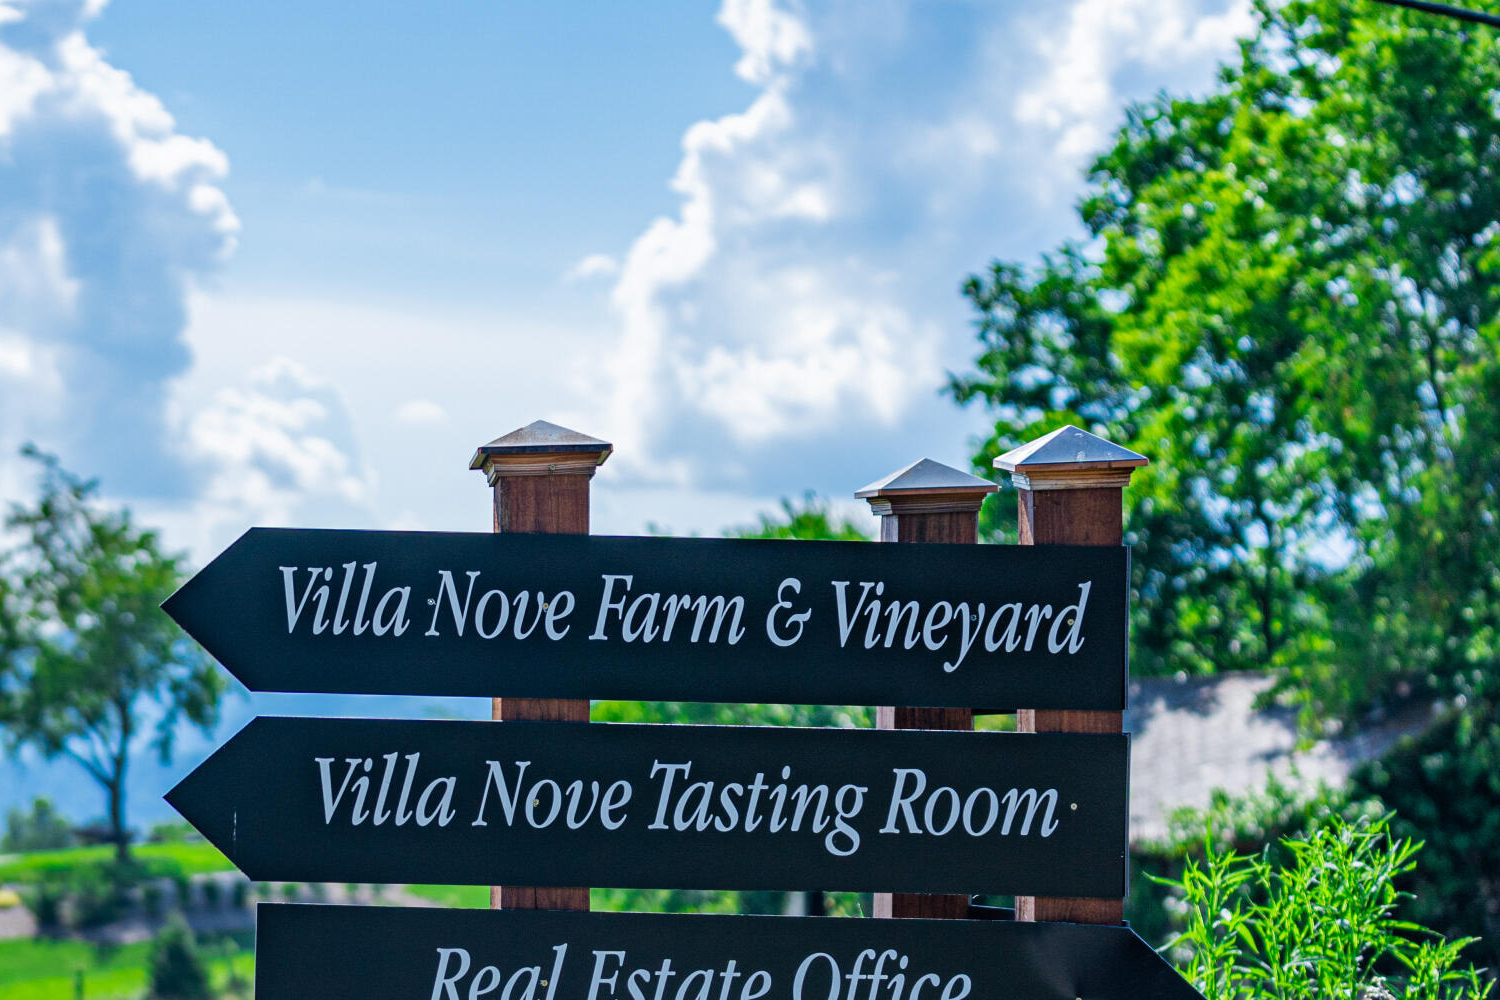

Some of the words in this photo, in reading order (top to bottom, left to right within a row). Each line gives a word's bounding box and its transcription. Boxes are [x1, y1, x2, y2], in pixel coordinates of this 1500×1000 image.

[278, 560, 411, 637] Villa
[425, 570, 575, 641] Nove
[588, 574, 746, 645] Farm
[766, 577, 812, 647] &
[831, 580, 1092, 673] Vineyard
[314, 751, 457, 827] Villa
[471, 760, 632, 830] Nove
[647, 759, 869, 857] Tasting
[879, 768, 1059, 838] Room
